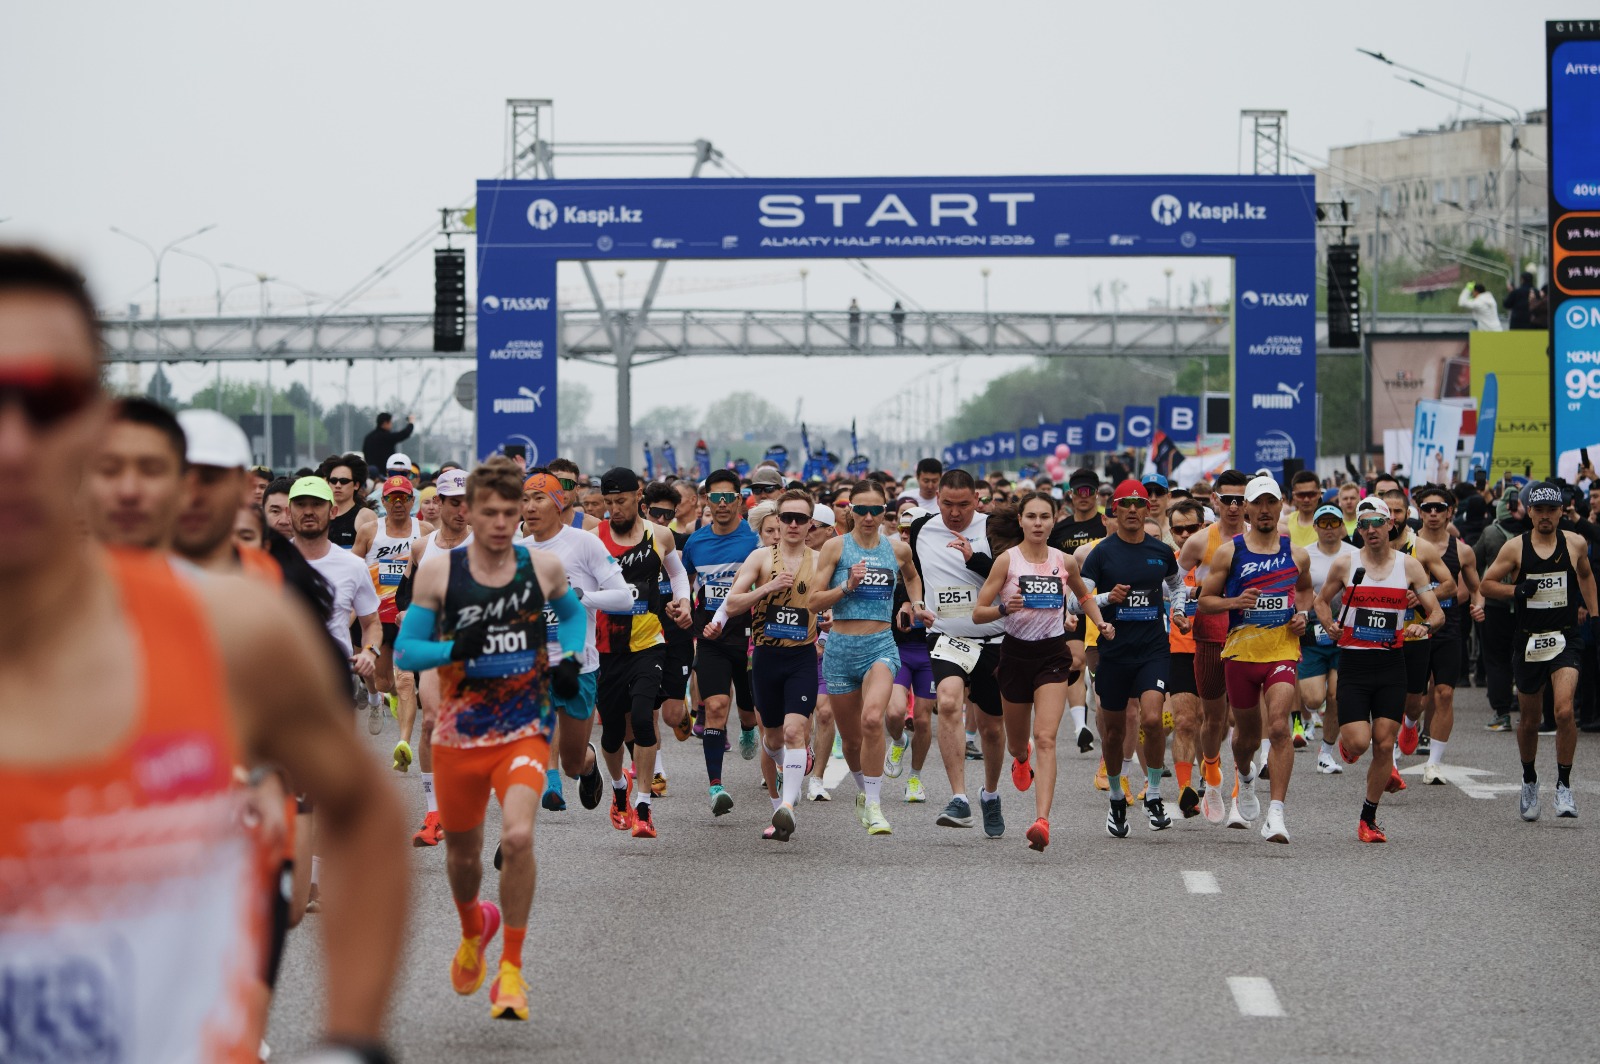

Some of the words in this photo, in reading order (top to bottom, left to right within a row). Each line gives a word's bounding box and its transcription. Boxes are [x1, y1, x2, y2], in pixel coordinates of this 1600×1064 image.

[1556, 22, 1600, 32] CITI
[1565, 62, 1600, 75] Апте
[564, 205, 642, 227] Kaspi.kz
[759, 193, 1035, 227] START
[1188, 202, 1266, 223] Kaspi.kz
[760, 237, 830, 247] ALMATY
[834, 236, 882, 246] HALF
[885, 236, 987, 246] MARATHON
[990, 235, 1035, 246] 2026
[502, 297, 550, 311] TASSAY
[1261, 293, 1309, 307] TASSAY
[1265, 336, 1303, 345] ASTANA
[489, 349, 542, 360] MOTORS
[1249, 345, 1302, 356] MOTORS
[493, 399, 534, 414] PUMA
[1252, 394, 1294, 409] PUMA
[1127, 415, 1152, 437] C
[1171, 407, 1194, 431] B
[1067, 427, 1083, 445] E
[1095, 422, 1116, 442] D
[999, 438, 1015, 454] H
[1022, 435, 1039, 451] G
[1042, 431, 1058, 448] F
[1492, 457, 1534, 468] 026
[1025, 581, 1059, 594] 3528
[1538, 577, 1563, 589] 38-1
[938, 591, 972, 604] E25-1
[1127, 595, 1149, 607] 124
[1249, 598, 1283, 610] 489
[776, 611, 799, 625] 912
[1368, 616, 1387, 629] 110
[948, 637, 971, 653] E25
[1534, 637, 1557, 650] E38
